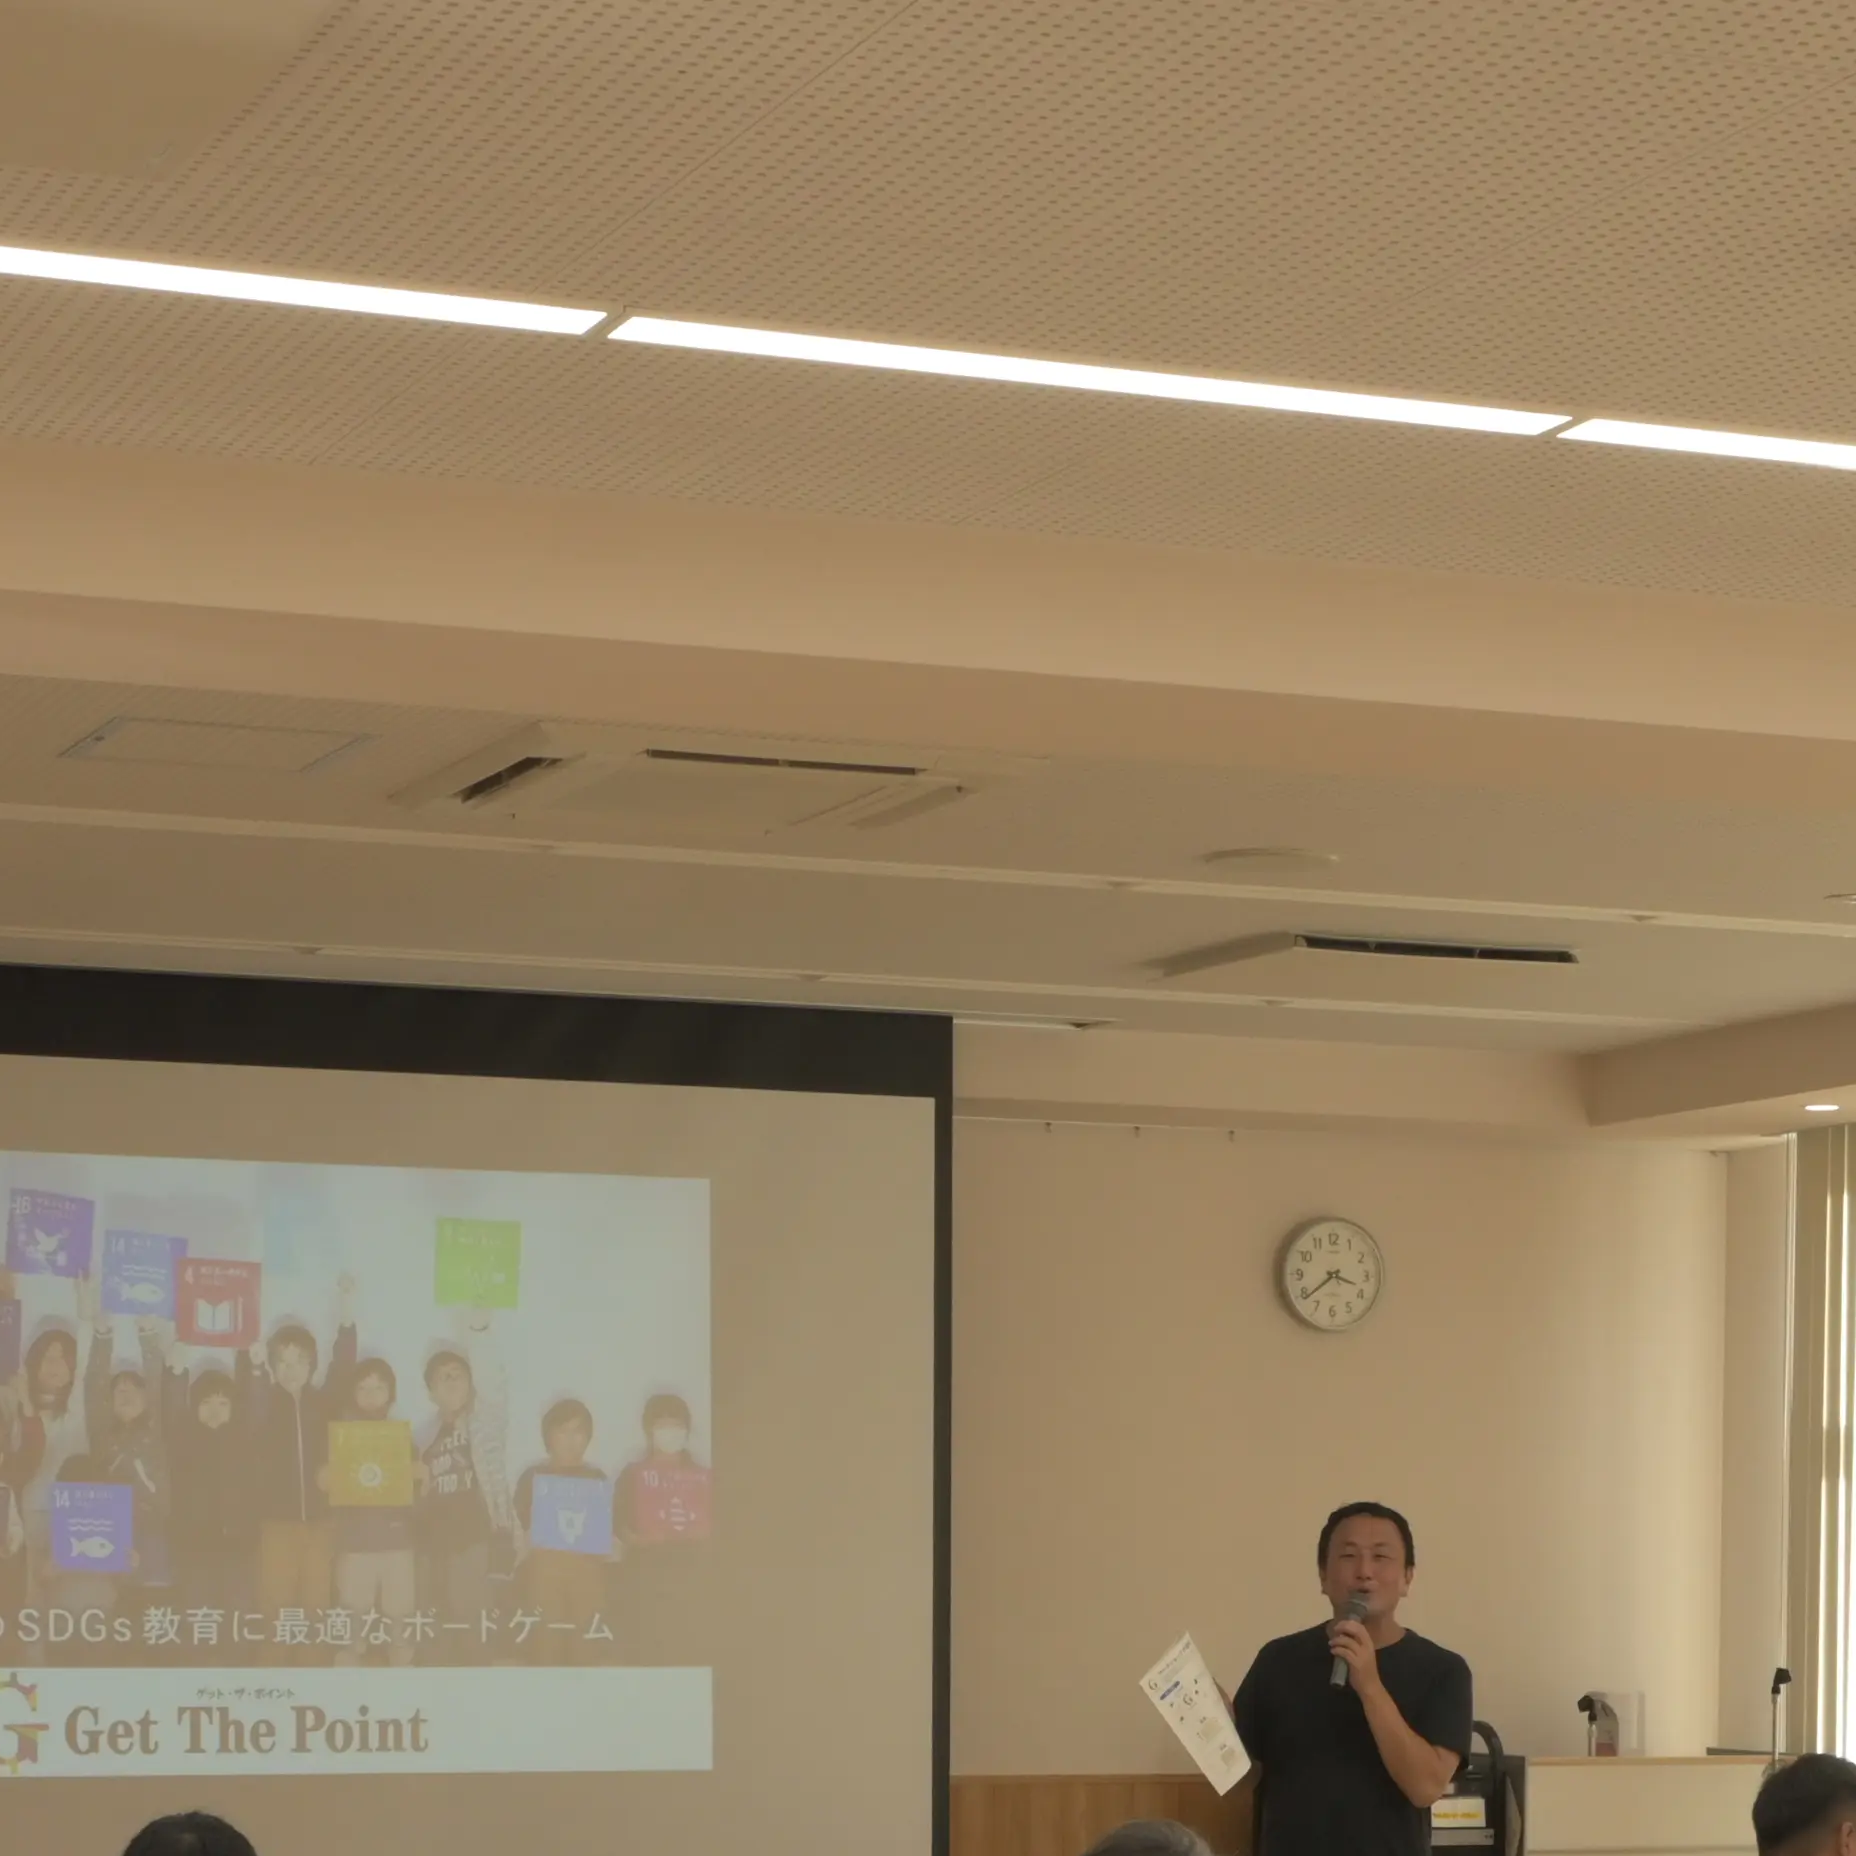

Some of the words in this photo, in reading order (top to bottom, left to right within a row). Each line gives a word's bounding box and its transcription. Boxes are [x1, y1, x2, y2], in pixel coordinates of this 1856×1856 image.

[1328, 1233, 1340, 1246] 12
[64, 1705, 158, 1755] Get
[177, 1706, 276, 1754] The
[290, 1704, 429, 1754] Point
